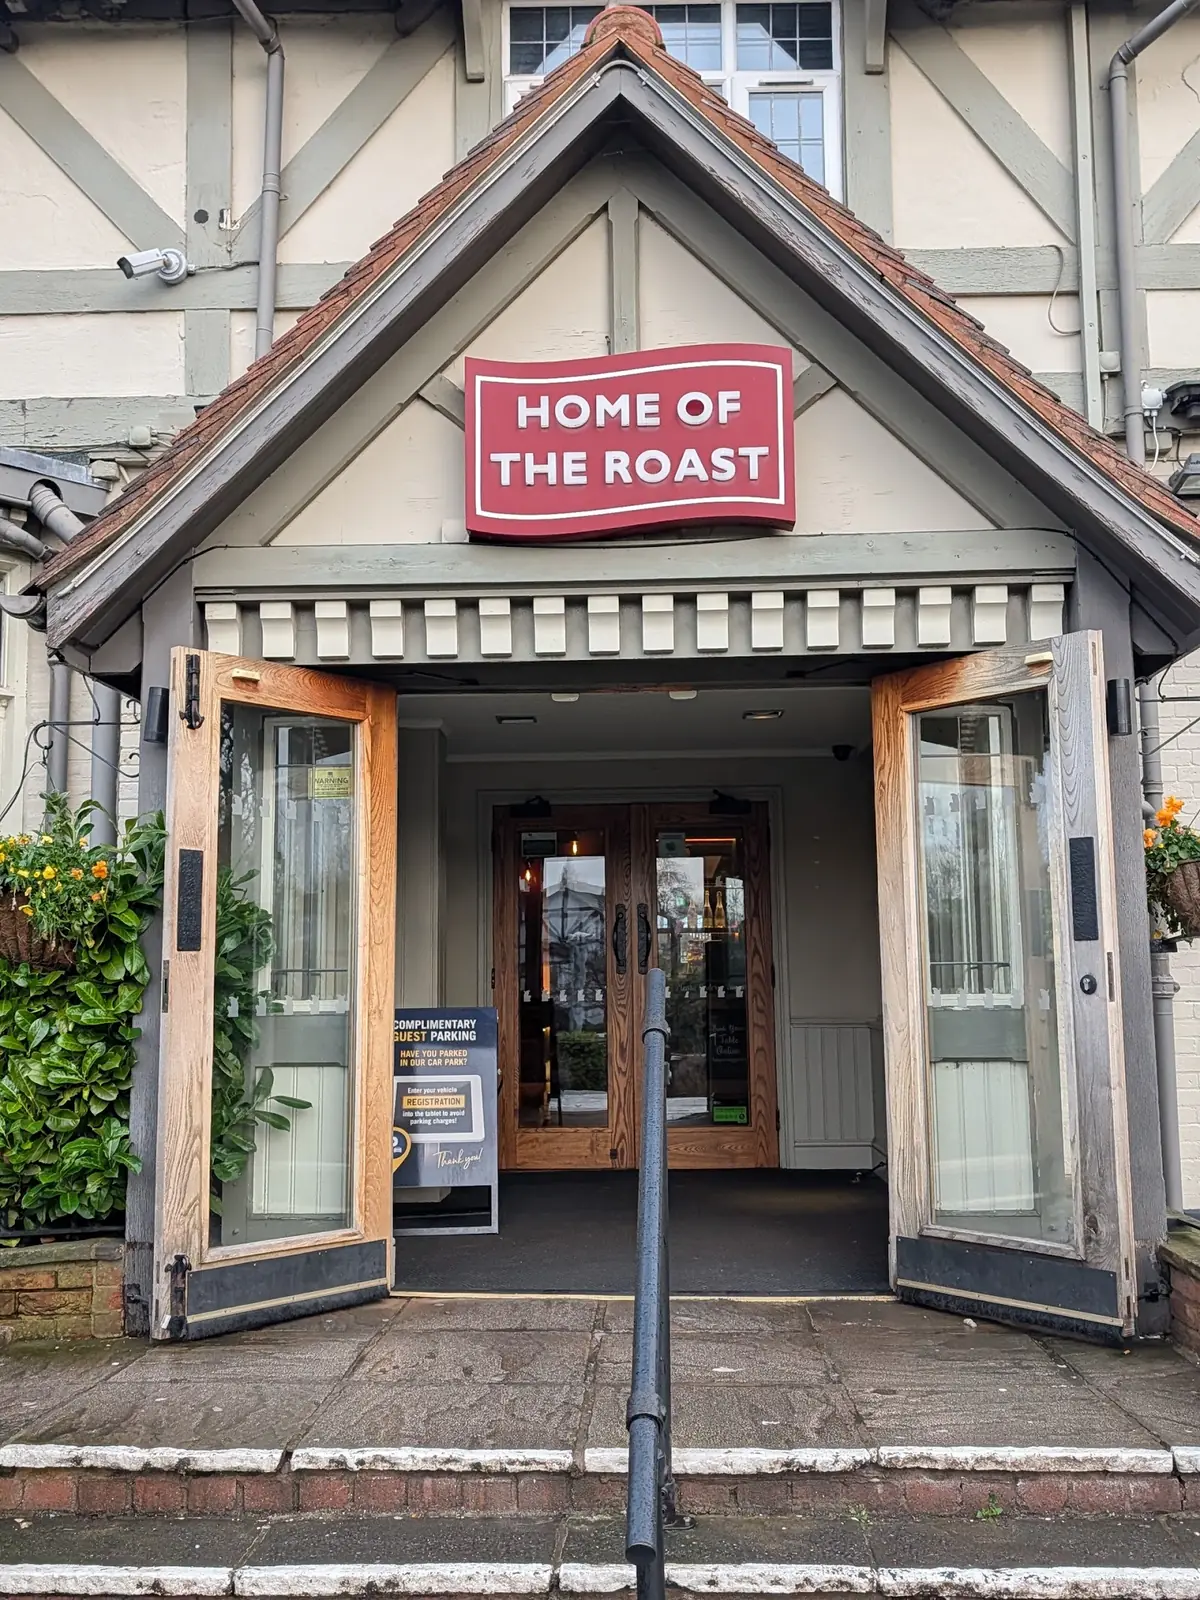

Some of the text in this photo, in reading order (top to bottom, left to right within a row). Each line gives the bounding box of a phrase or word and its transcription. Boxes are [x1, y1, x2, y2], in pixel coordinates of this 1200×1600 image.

[517, 390, 741, 429] HOME OF
[490, 446, 769, 486] THE ROAST
[394, 1019, 477, 1030] COMPLIMENTARY
[394, 1030, 477, 1042] GUEST PARKING
[400, 1050, 420, 1058] HAVE
[439, 1049, 468, 1057] PARKED
[400, 1058, 468, 1067] IN OUR CAR PARK?
[406, 1097, 461, 1106] REGISTRATION
[410, 1118, 432, 1126] parking
[432, 1148, 464, 1168] Thank
